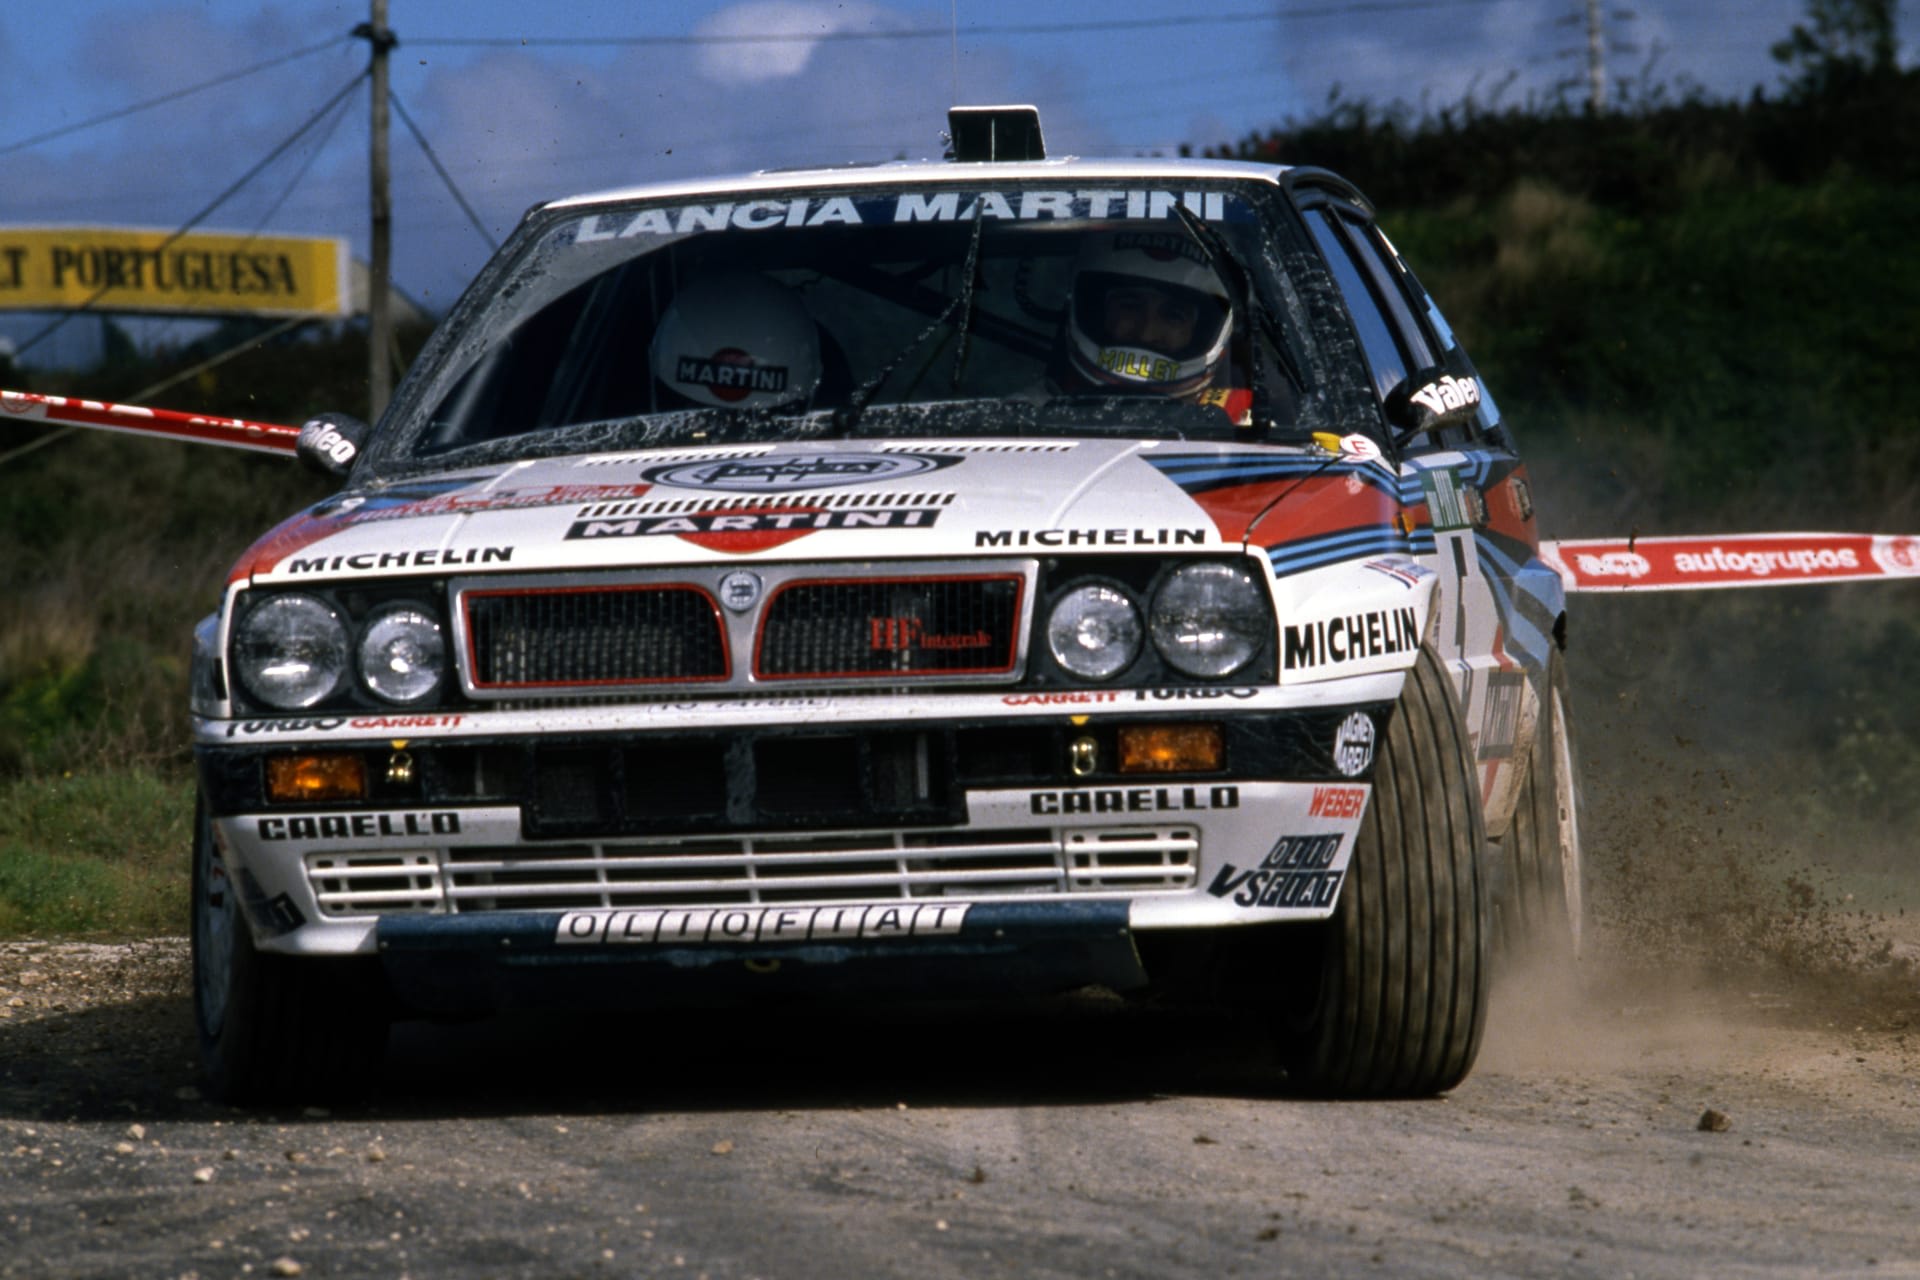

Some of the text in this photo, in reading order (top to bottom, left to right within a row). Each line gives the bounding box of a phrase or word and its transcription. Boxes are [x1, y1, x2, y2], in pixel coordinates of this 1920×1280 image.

[575, 191, 1227, 244] LANCIA MARTINI
[53, 246, 296, 295] PORTUGUESA
[679, 362, 787, 393] MARTINI
[1097, 350, 1181, 381] MILLET
[582, 509, 925, 537] MARTINI
[975, 528, 1207, 548] MICHELIN
[288, 546, 514, 574] MICHELIN
[1674, 547, 1859, 577] autogrupos
[871, 617, 922, 650] HF
[1284, 607, 1419, 670] MICHELIN
[1030, 786, 1239, 814] CARELLO
[1309, 787, 1366, 818] WEBER
[258, 812, 461, 841] CARELLO
[1265, 836, 1338, 868] OLIO
[1261, 873, 1340, 906] FIAT
